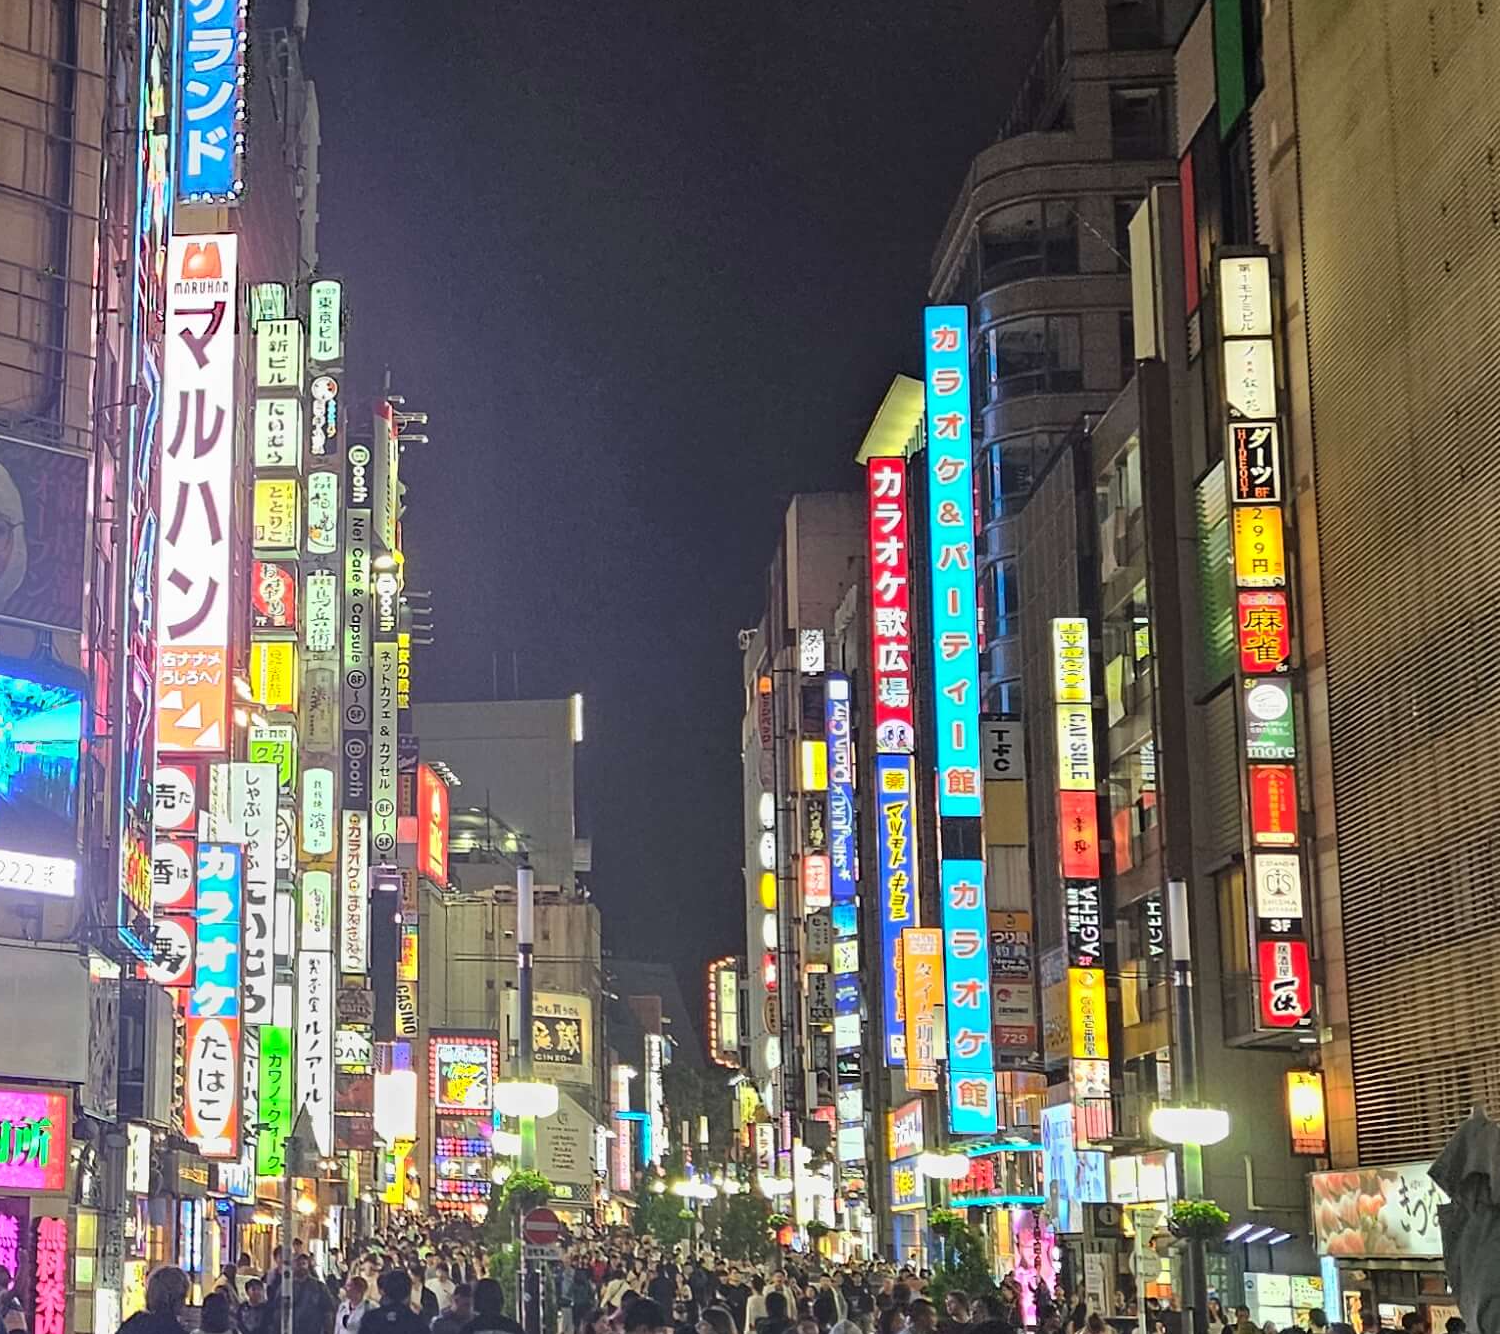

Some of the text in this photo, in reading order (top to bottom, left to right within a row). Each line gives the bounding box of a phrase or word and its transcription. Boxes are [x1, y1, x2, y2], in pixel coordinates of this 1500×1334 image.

[317, 296, 333, 354] 東京ビル
[266, 400, 285, 465] にいむら
[1235, 427, 1249, 498] HIDEOUT
[1249, 427, 1272, 486] ダーツ
[166, 300, 227, 641] マルハン
[931, 325, 977, 796] カラオケ&パーティー館
[1251, 507, 1269, 574] 299円
[350, 517, 365, 664] Net Cafe & Capsule
[873, 465, 911, 710] カラオケ歌広場
[1243, 608, 1284, 661] 麻雀
[379, 650, 392, 719] ネットカフェ
[345, 738, 366, 799] Booth
[379, 742, 392, 790] カプセル
[1246, 745, 1296, 759] more
[884, 803, 909, 920] マツモトキヨシ
[193, 845, 238, 1017] カラオケ
[1079, 884, 1101, 958] AGEHA
[1270, 919, 1292, 933] 3F
[399, 984, 417, 1036] CASINO
[951, 881, 990, 1110] カラオケ館
[1273, 979, 1299, 1013] 一休
[1001, 1033, 1029, 1044] 729
